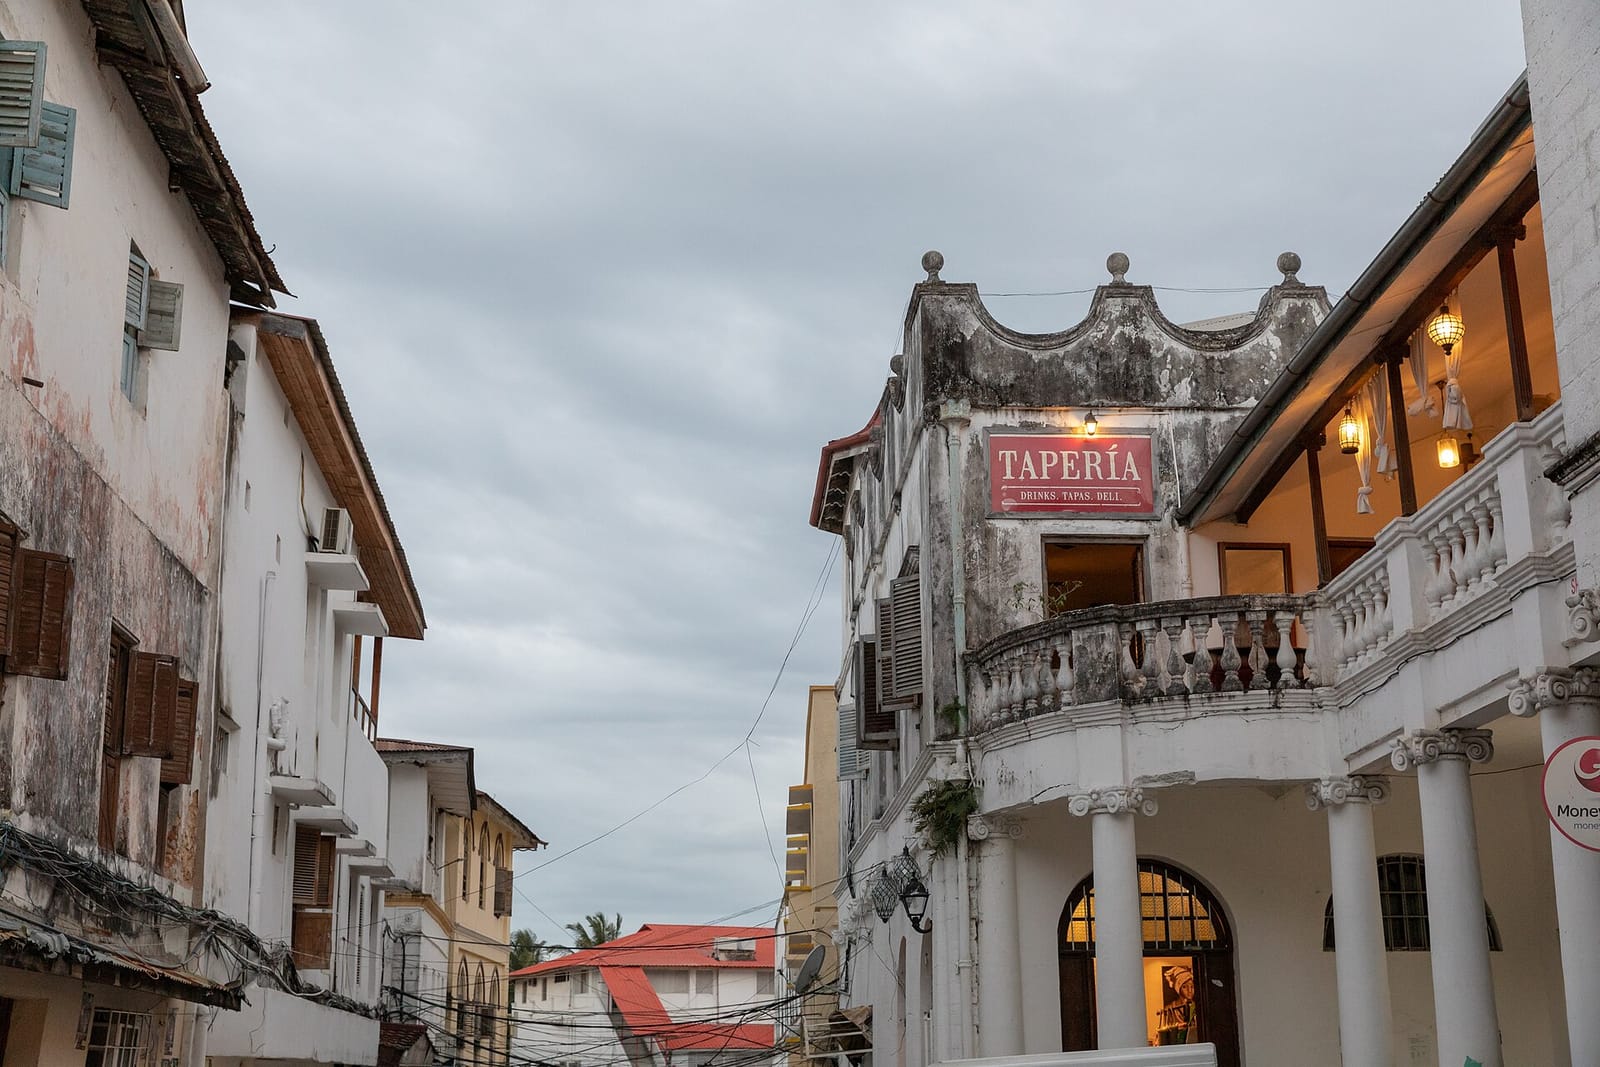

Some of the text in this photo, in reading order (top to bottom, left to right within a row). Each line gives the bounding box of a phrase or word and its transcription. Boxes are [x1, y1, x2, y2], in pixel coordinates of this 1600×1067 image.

[999, 444, 1141, 481] TAPERÍA
[1021, 491, 1123, 502] DRINKS. TAPAS. DELI.
[1557, 804, 1600, 818] Mone
[1573, 822, 1600, 830] mone
